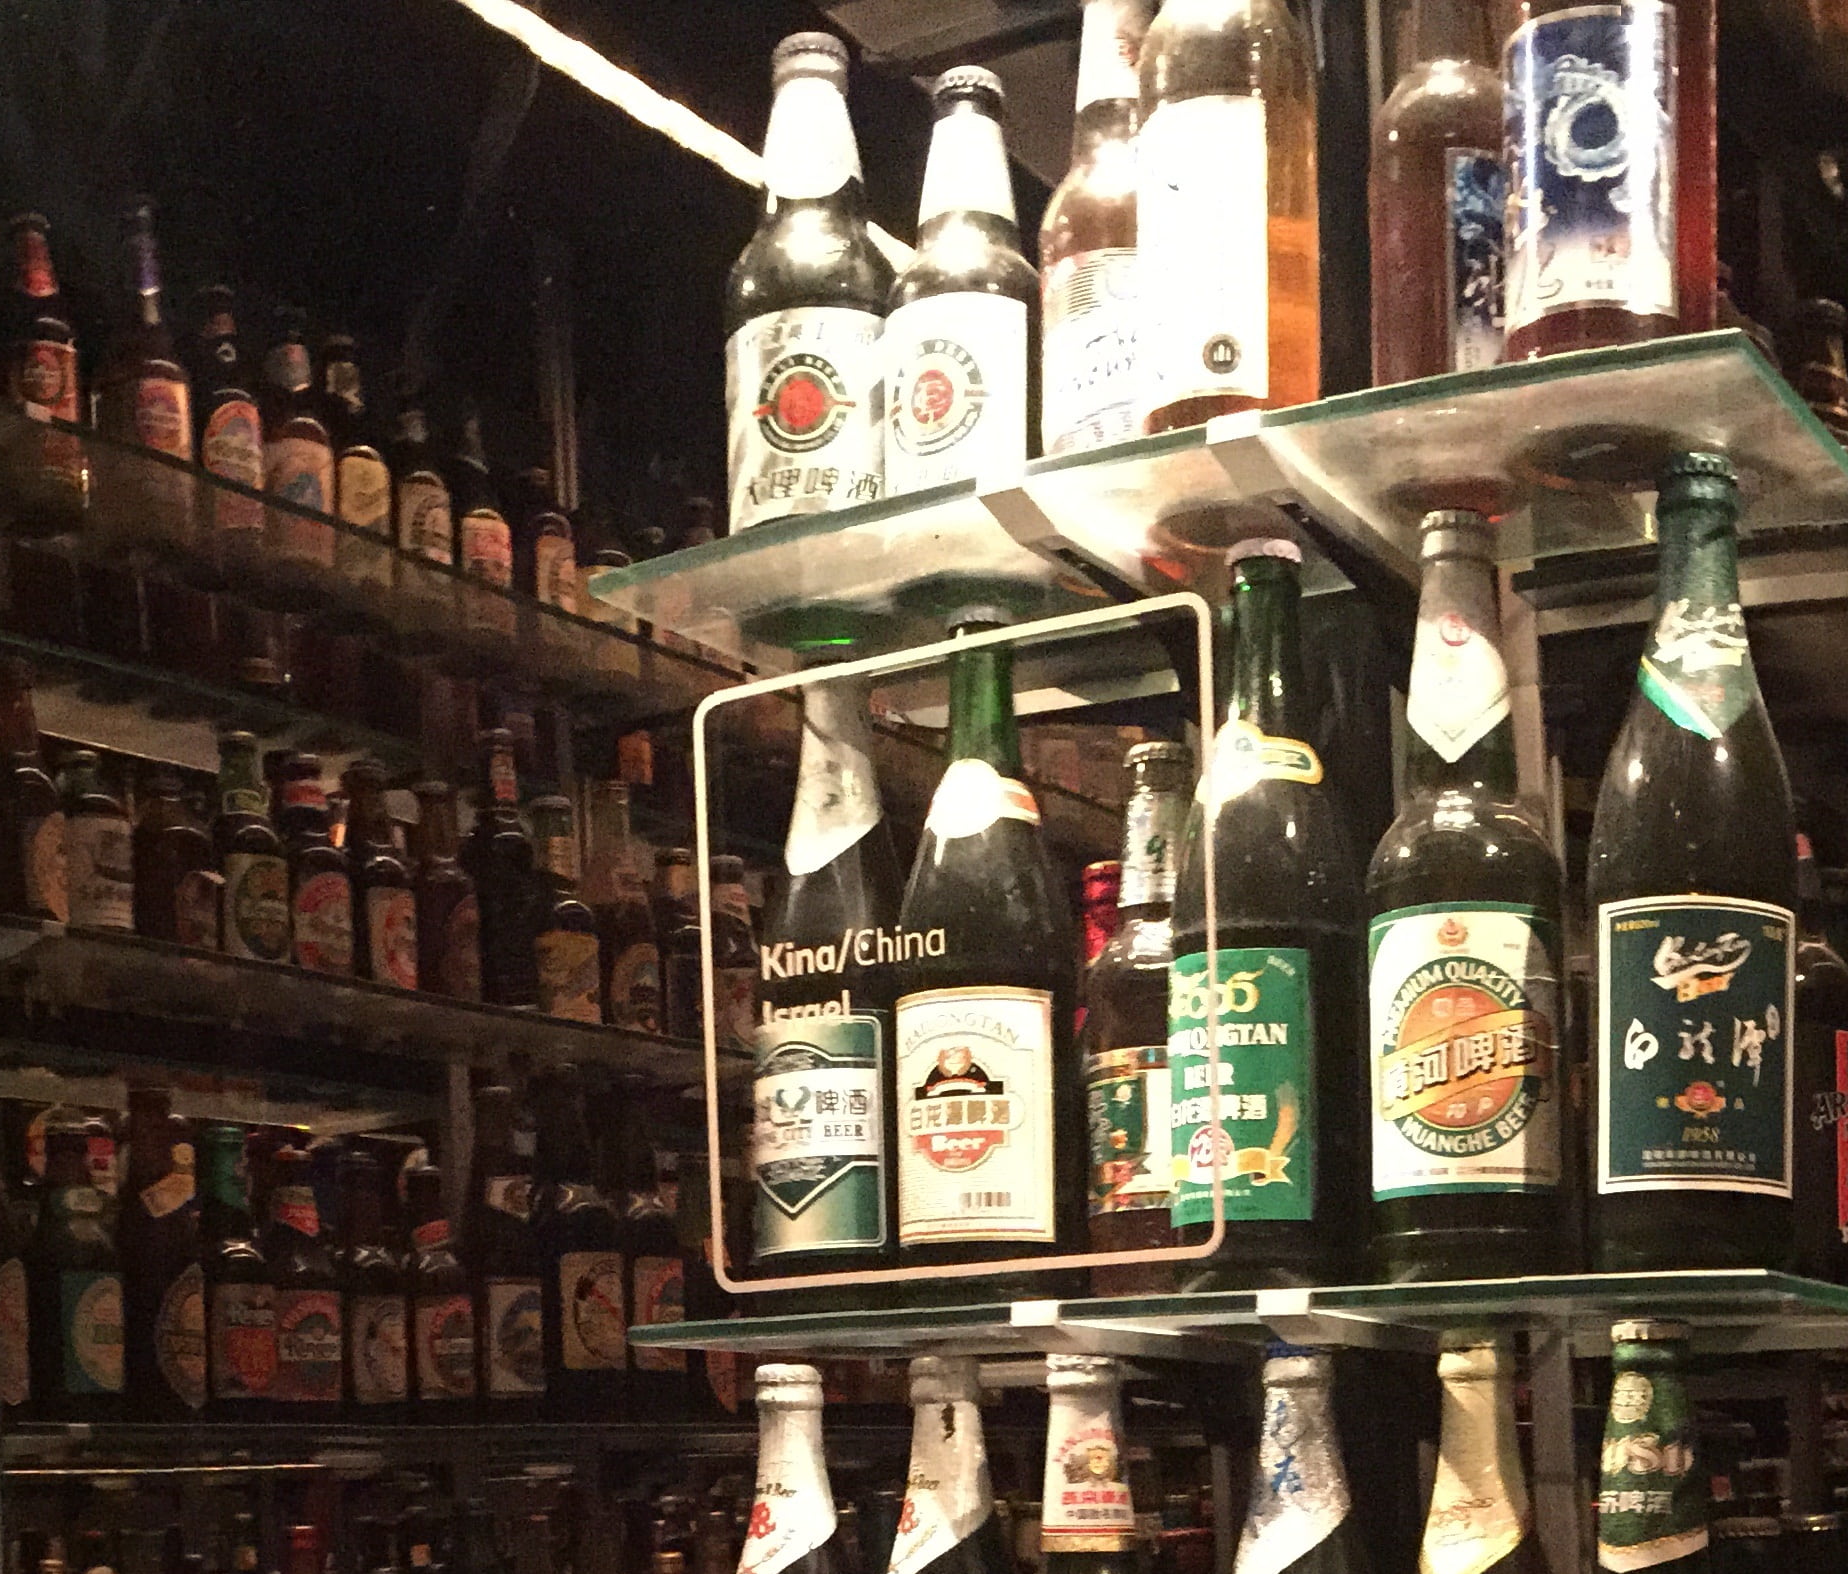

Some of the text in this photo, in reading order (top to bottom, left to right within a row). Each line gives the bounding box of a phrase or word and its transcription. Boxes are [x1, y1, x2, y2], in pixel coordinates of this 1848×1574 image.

[761, 925, 947, 982] Kina/China
[1444, 960, 1524, 1008] QUALITY
[762, 990, 851, 1025] Israel
[815, 1088, 868, 1115] 啤酒
[823, 1122, 865, 1140] BEER
[1400, 1115, 1495, 1154] HUANGHE
